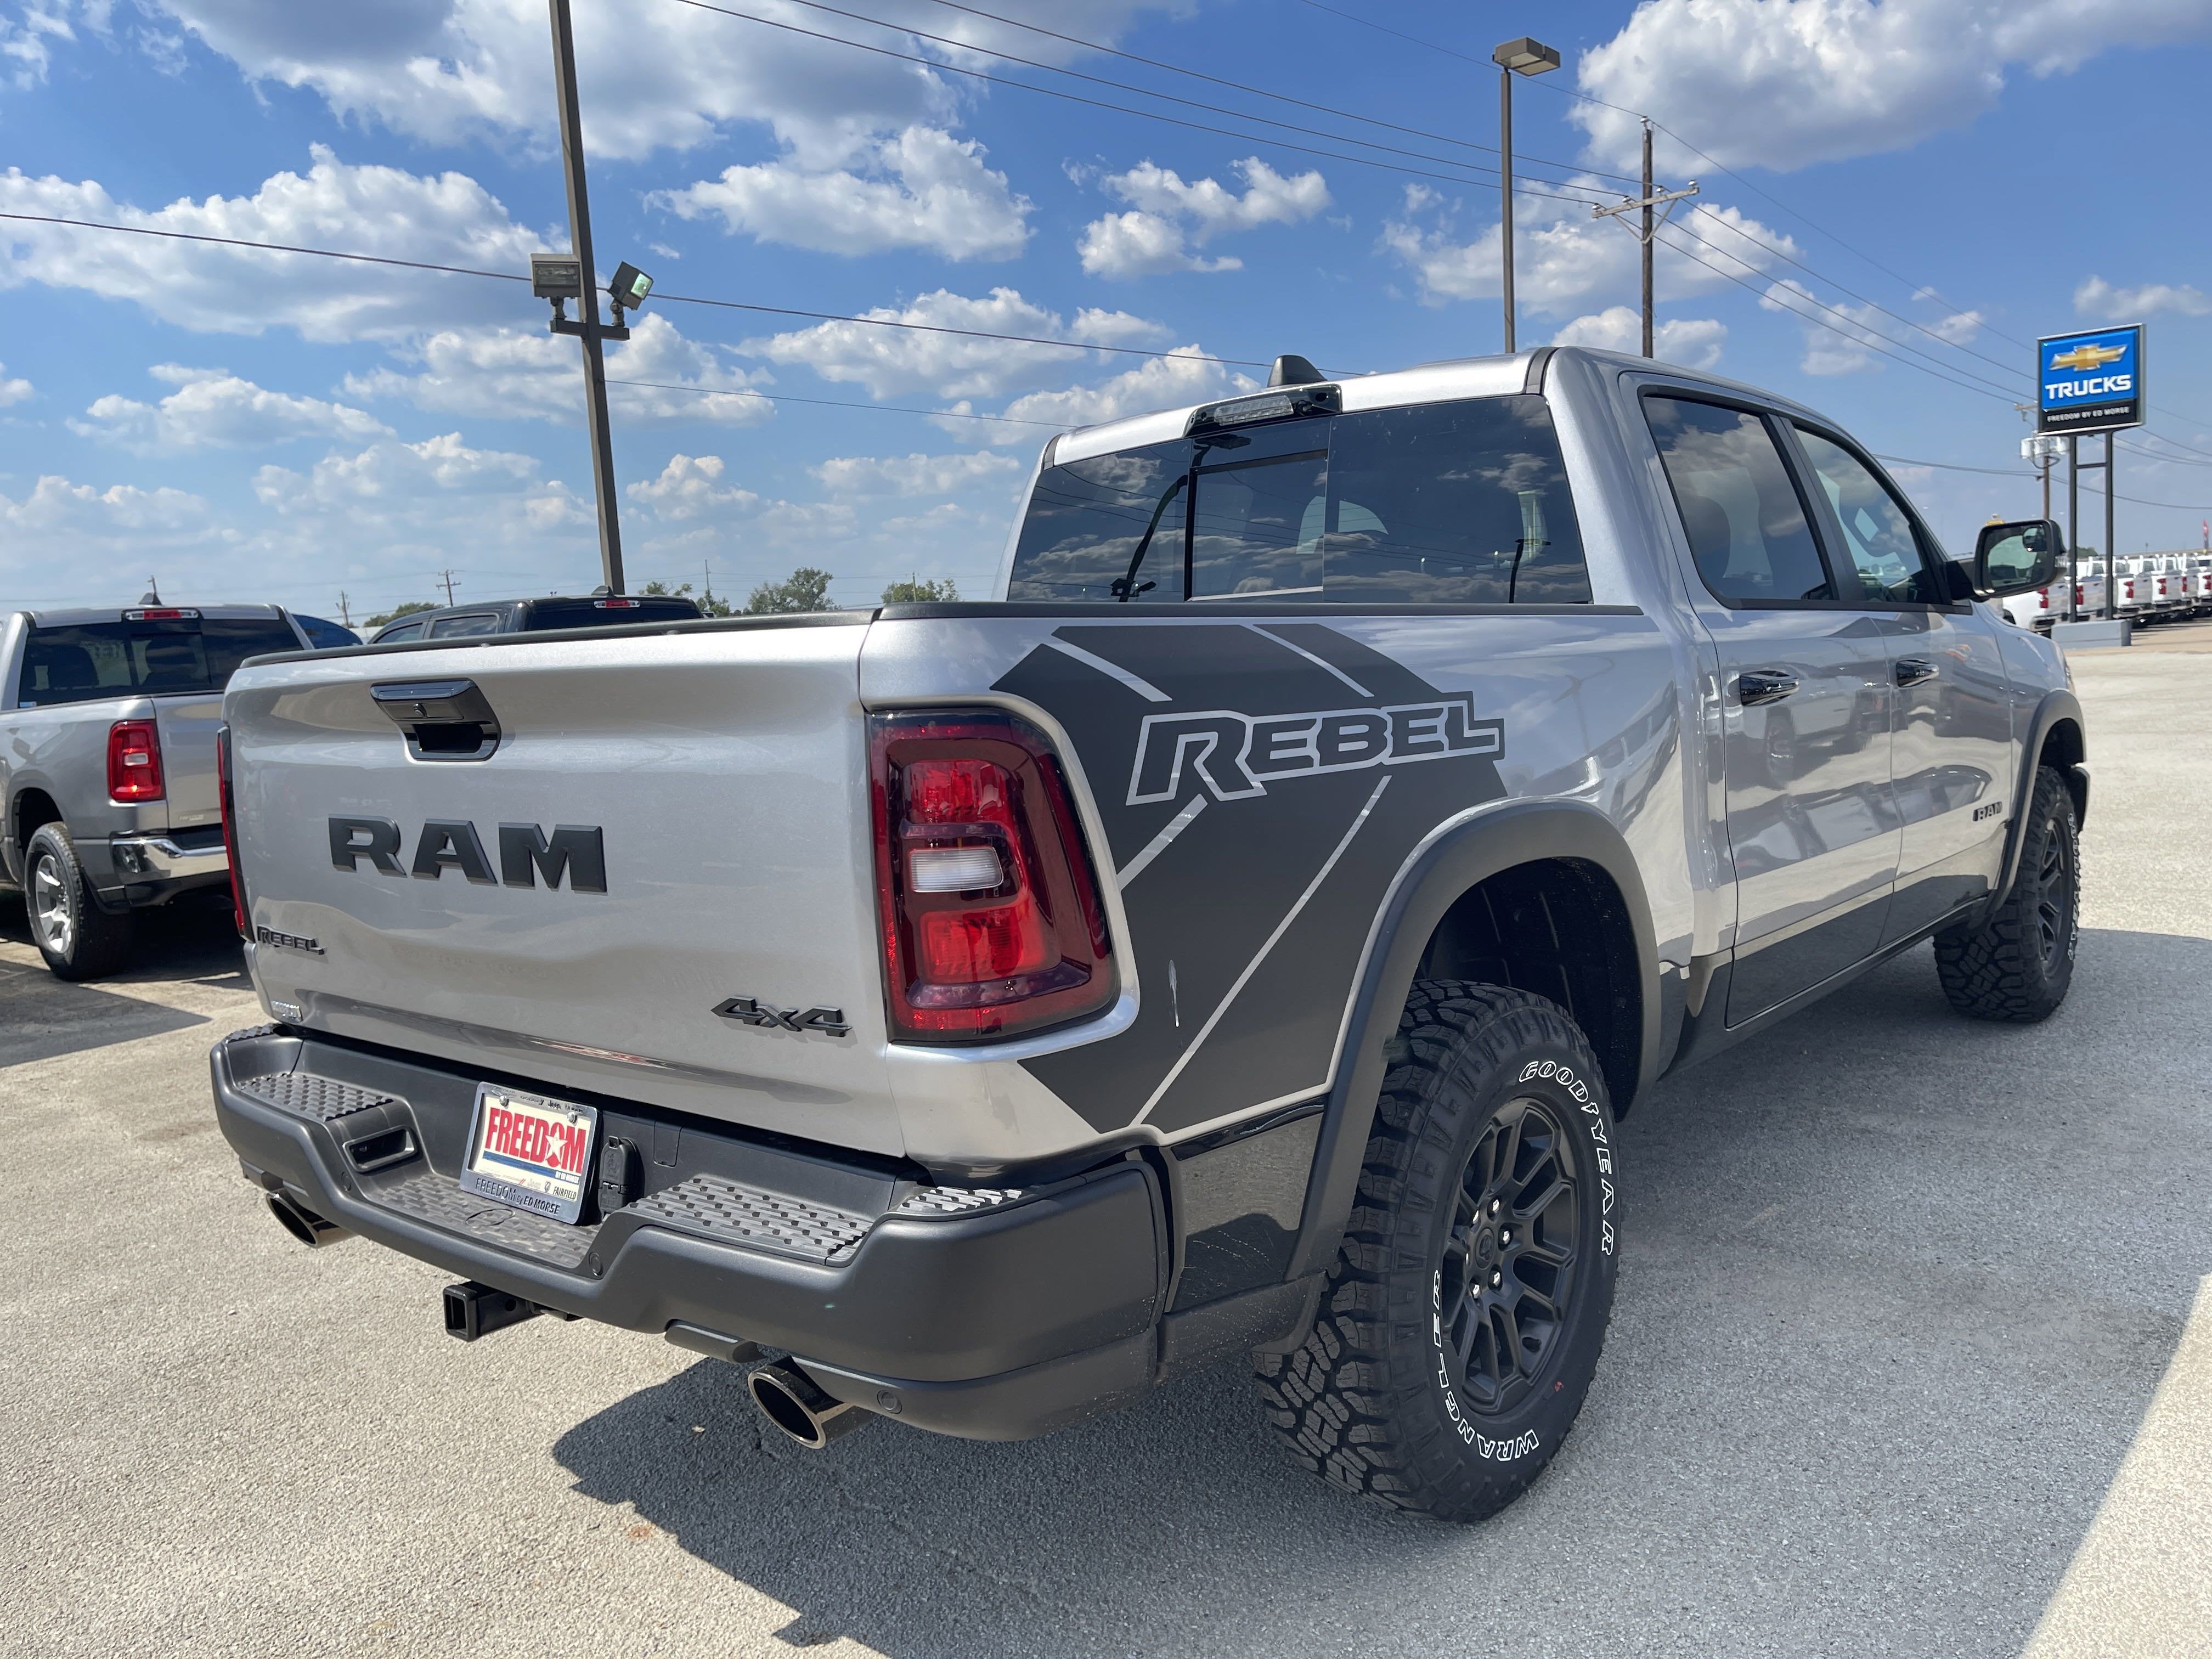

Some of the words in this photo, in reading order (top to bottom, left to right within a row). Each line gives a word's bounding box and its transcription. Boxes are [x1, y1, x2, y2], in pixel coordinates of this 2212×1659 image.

[2045, 374, 2131, 399] TRUCKS
[2047, 412, 2080, 422] FREEDOM
[2104, 406, 2130, 415] MORSE
[1126, 699, 1499, 806] REBEL
[1973, 801, 2002, 822] RAM
[328, 813, 608, 896] RAM
[257, 924, 325, 955] REBEL
[484, 1107, 586, 1174] FREEDOM
[1519, 1060, 1614, 1256] GOODYEAR
[475, 1178, 516, 1200] FREEDOM
[523, 1195, 534, 1206] ED
[534, 1199, 561, 1215] MORSE
[553, 1186, 577, 1200] FAIRFIELD
[1433, 1269, 1539, 1462] WRANGLER
